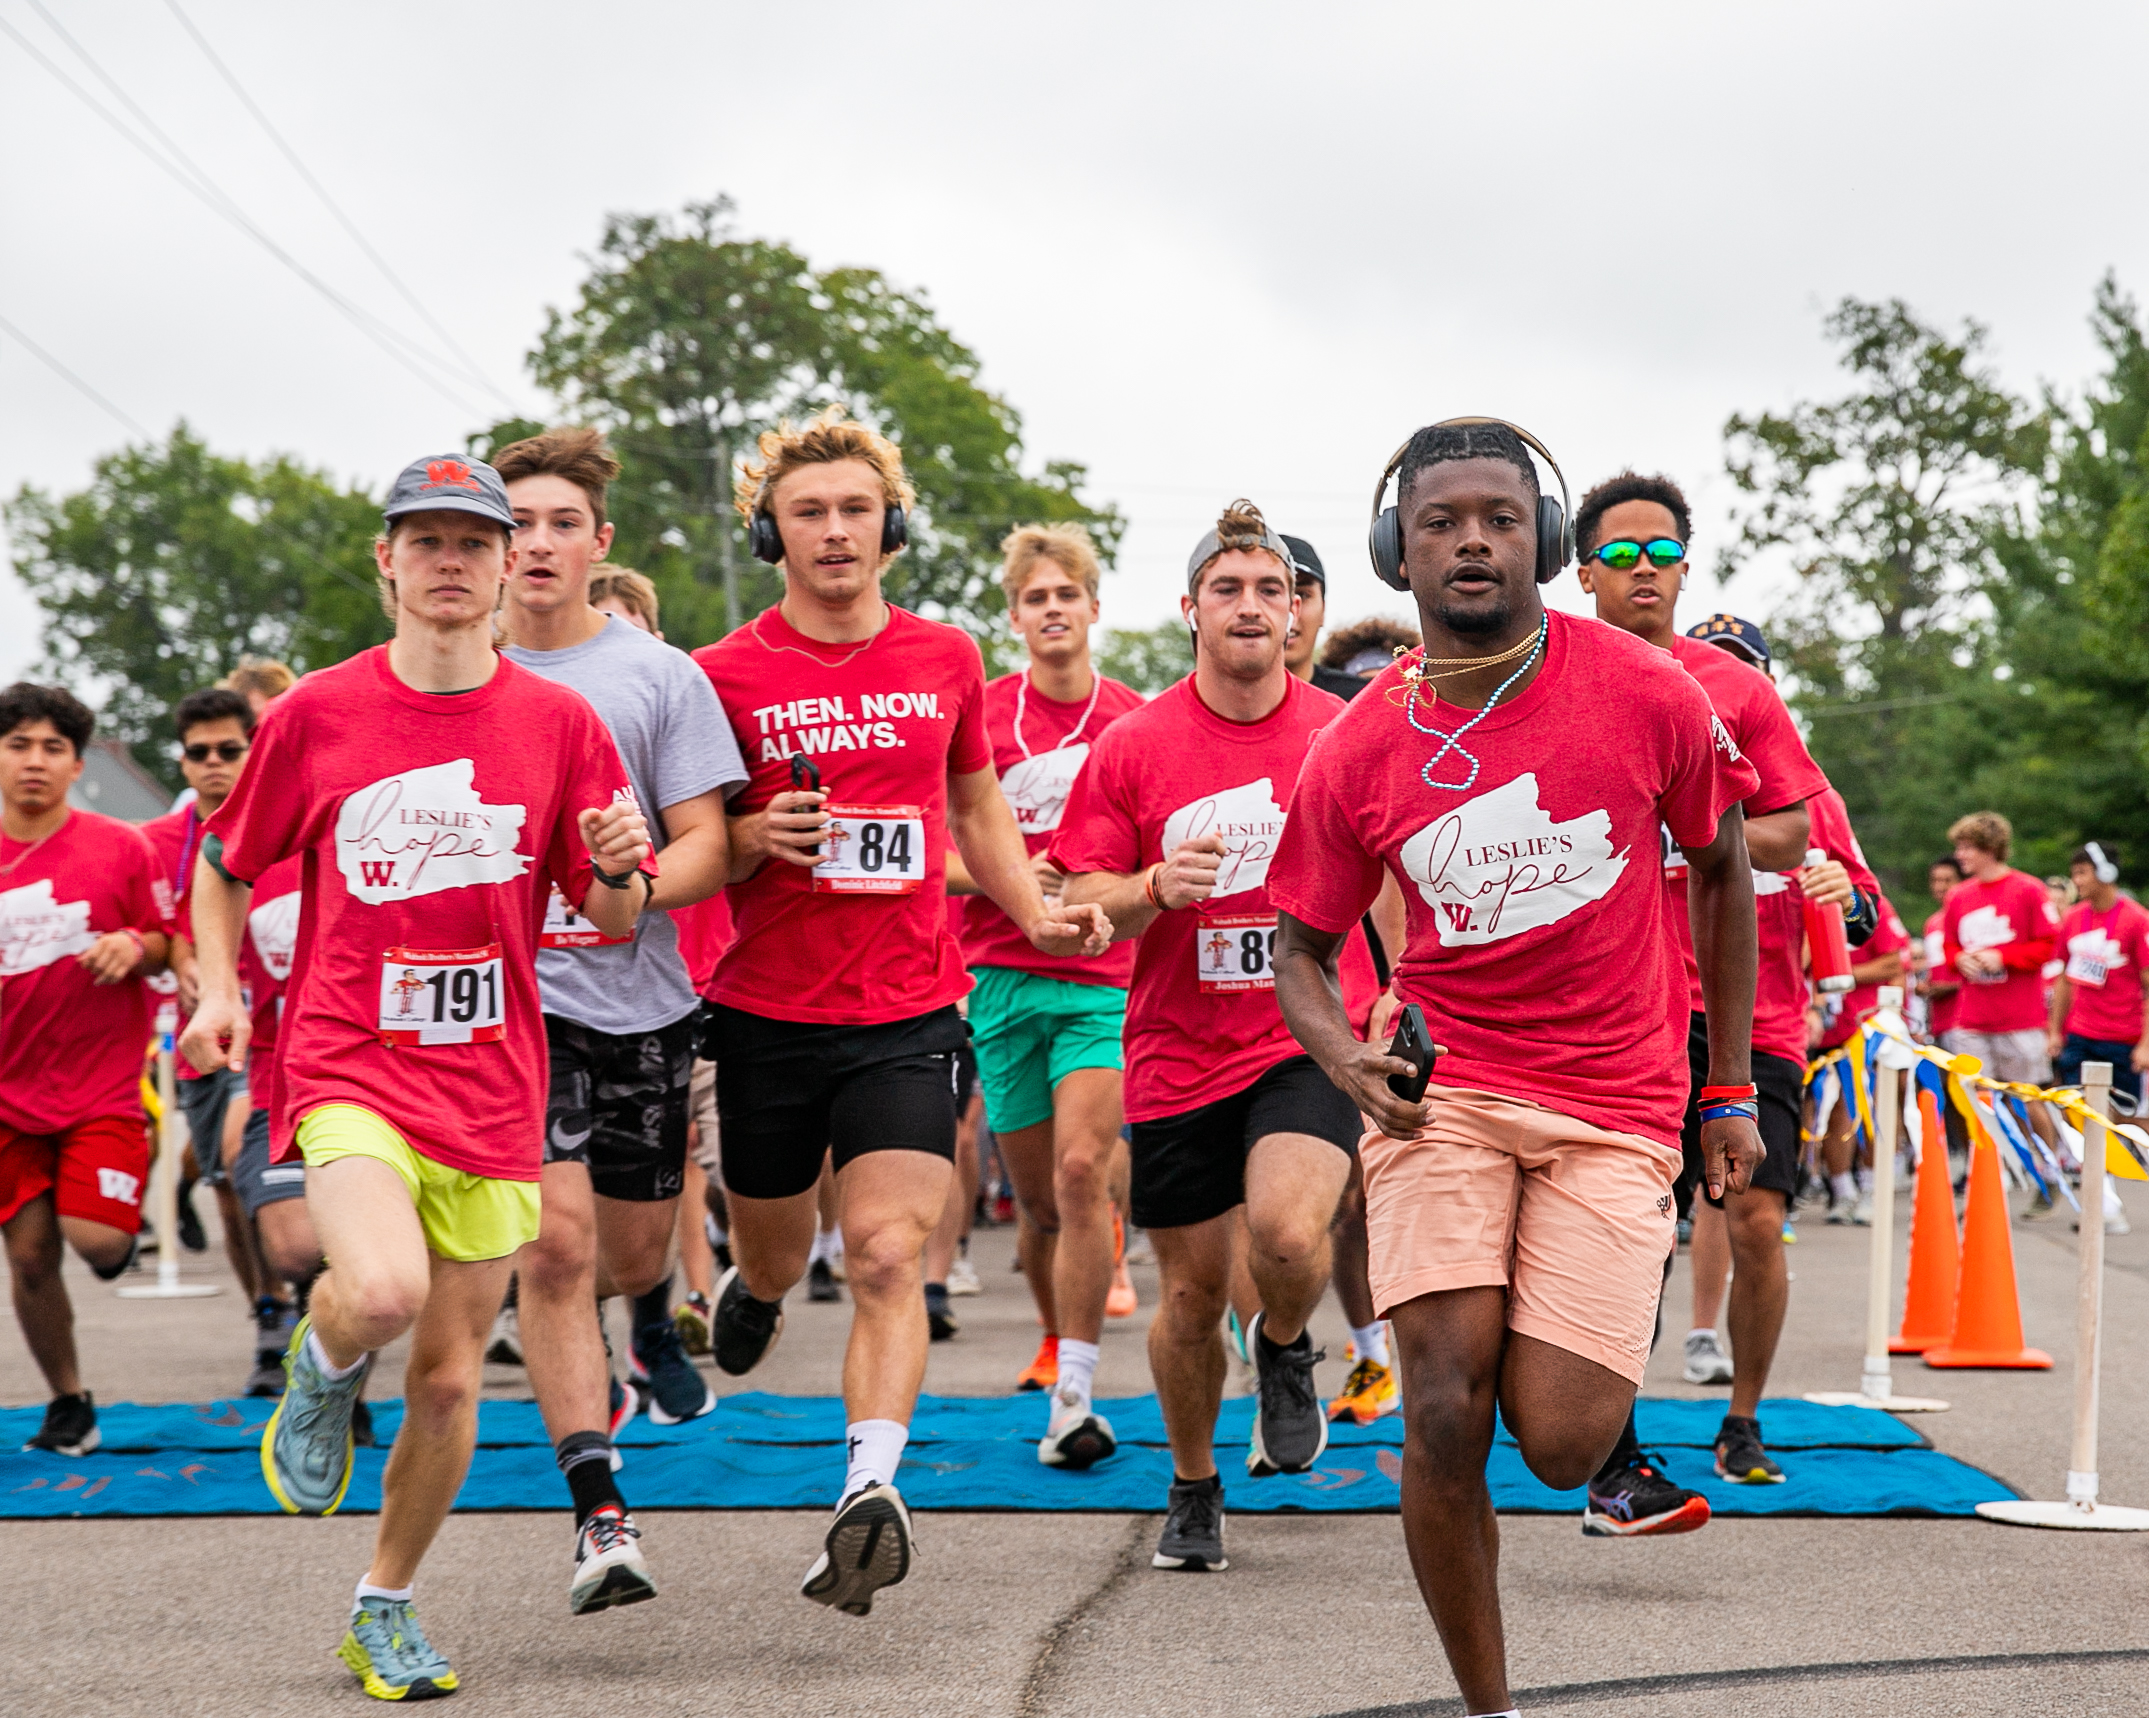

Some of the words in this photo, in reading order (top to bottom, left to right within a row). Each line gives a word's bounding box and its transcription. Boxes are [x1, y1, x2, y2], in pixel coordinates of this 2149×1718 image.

[752, 696, 853, 734] THEN.
[860, 692, 945, 720] NOW.
[761, 721, 906, 763] ALWAYS.
[344, 779, 501, 891] hope
[400, 808, 493, 832] LESLIE'S
[860, 822, 912, 873] 84
[1464, 834, 1573, 868] LESLIE'S
[1416, 814, 1594, 935] hope
[427, 964, 497, 1023] 191
[1214, 981, 1251, 991] Joshua
